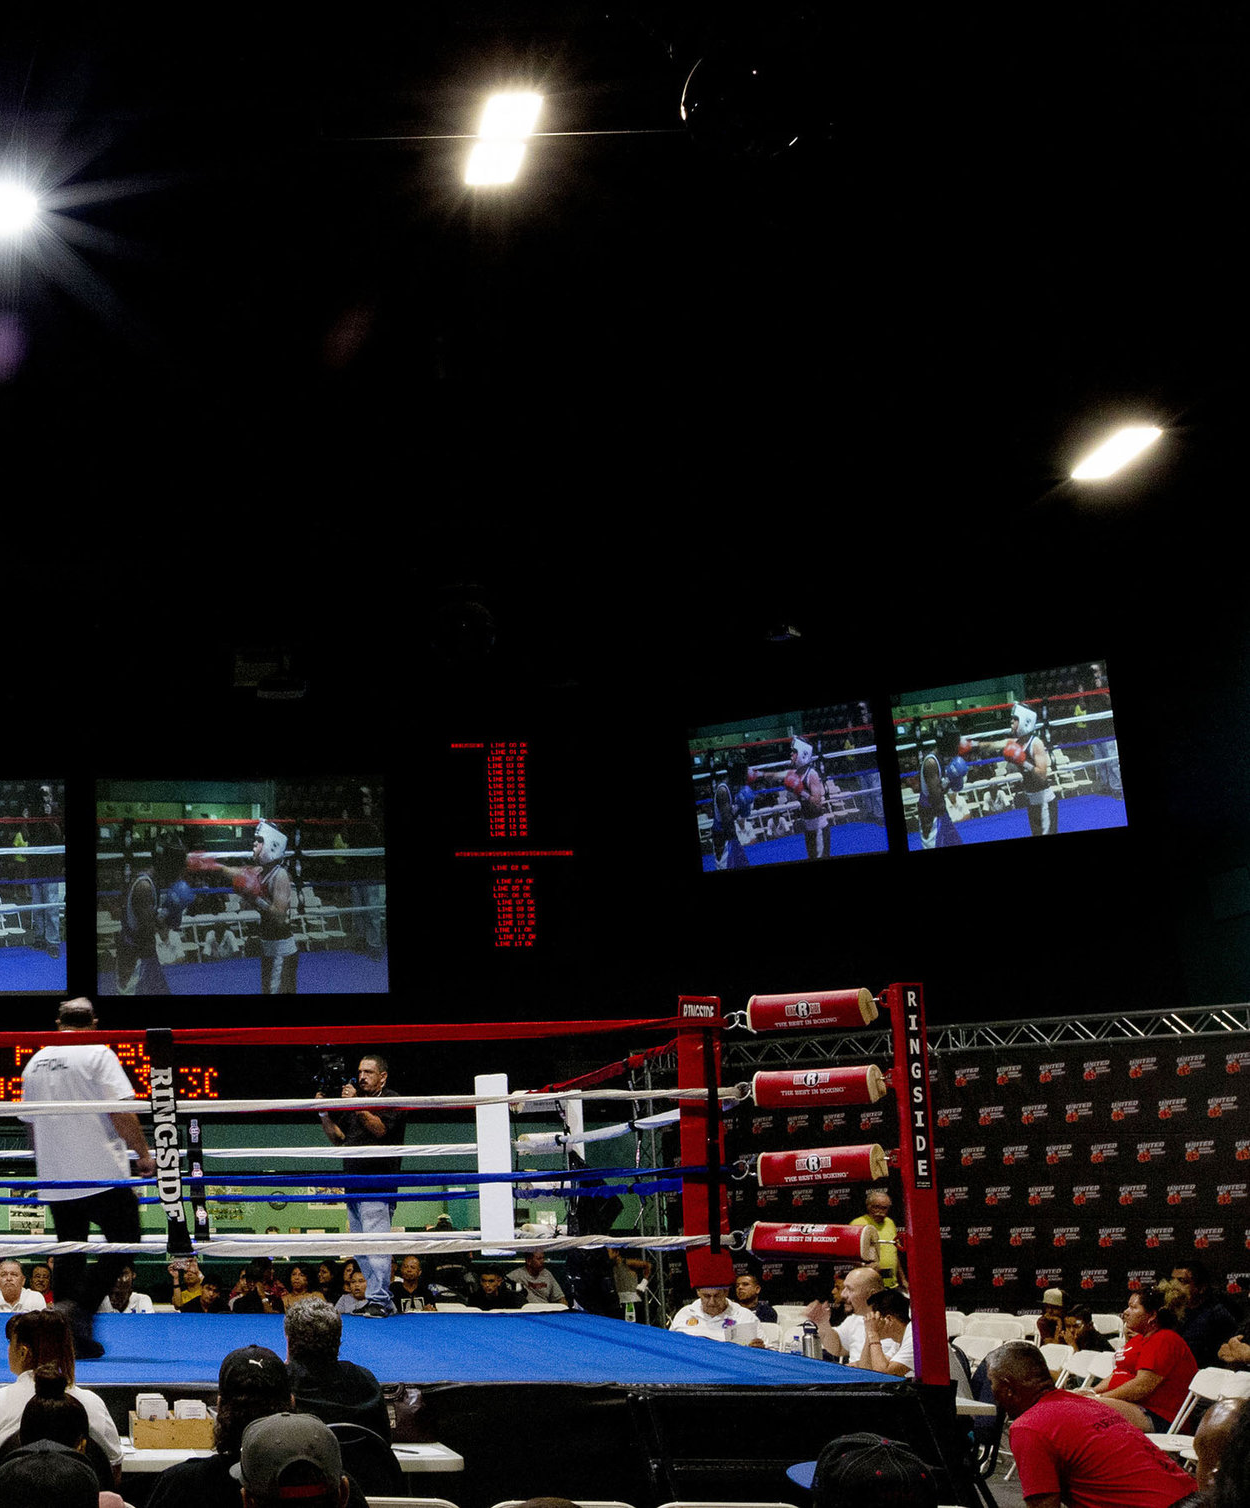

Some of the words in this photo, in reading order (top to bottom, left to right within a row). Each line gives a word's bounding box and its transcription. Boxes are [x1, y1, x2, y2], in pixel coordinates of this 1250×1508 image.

[1129, 1057, 1156, 1065] UNITED
[1177, 1054, 1205, 1062] UNITED
[997, 1064, 1022, 1072] UNITED
[1040, 1062, 1065, 1070] UNITED
[1083, 1060, 1110, 1068] UNITED
[907, 991, 928, 1176] RINGSIDE
[1111, 1100, 1138, 1108] UNITED
[1158, 1098, 1187, 1106] UNITED
[1208, 1096, 1236, 1104] UNITED
[1022, 1104, 1047, 1112] UNITED
[150, 1066, 185, 1222] RINGSIDE
[1137, 1141, 1164, 1149] UNITED
[1185, 1140, 1214, 1148] UNITED
[961, 1146, 985, 1154] UNITED
[1119, 1184, 1146, 1192] UNITED
